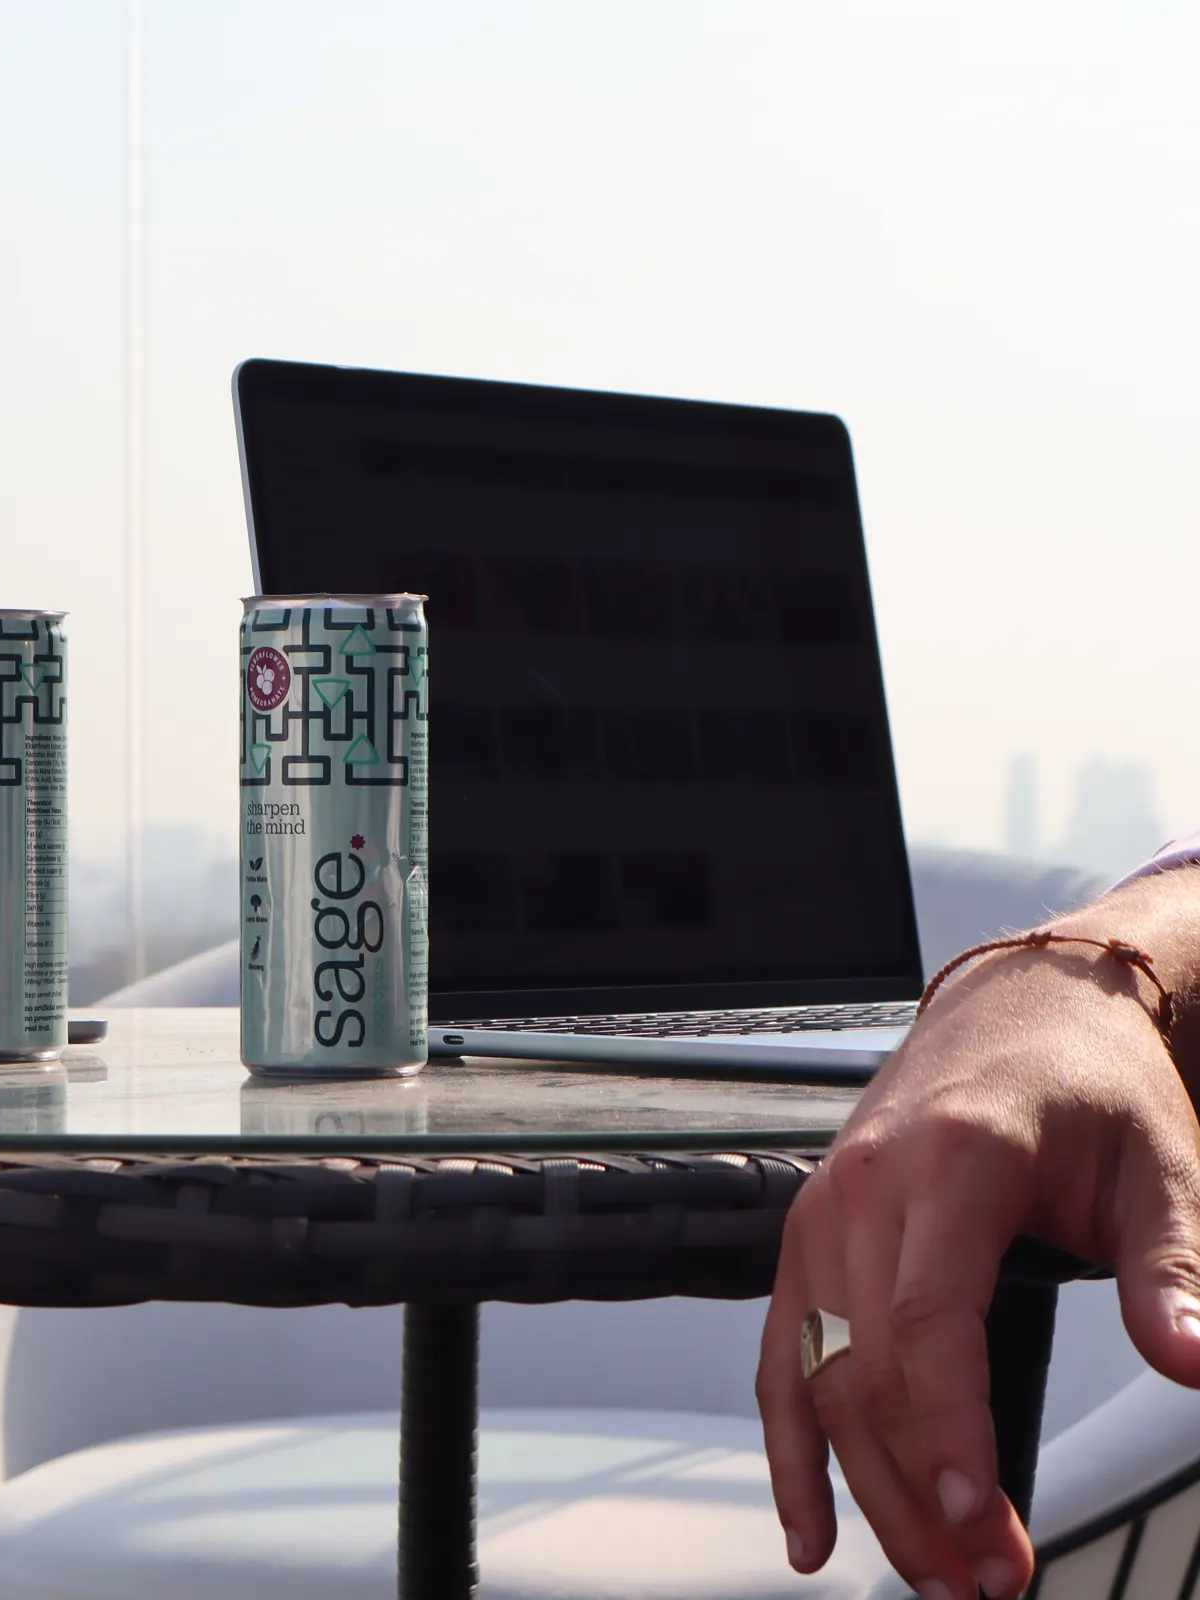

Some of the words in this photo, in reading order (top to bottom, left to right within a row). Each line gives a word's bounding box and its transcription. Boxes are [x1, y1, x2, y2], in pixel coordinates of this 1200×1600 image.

[250, 651, 285, 672] ELDERFLOWER
[250, 685, 285, 707] POMEGRANATE
[247, 800, 301, 819] sharpen
[246, 819, 262, 835] the
[265, 819, 306, 835] mind
[310, 852, 384, 1047] sage
